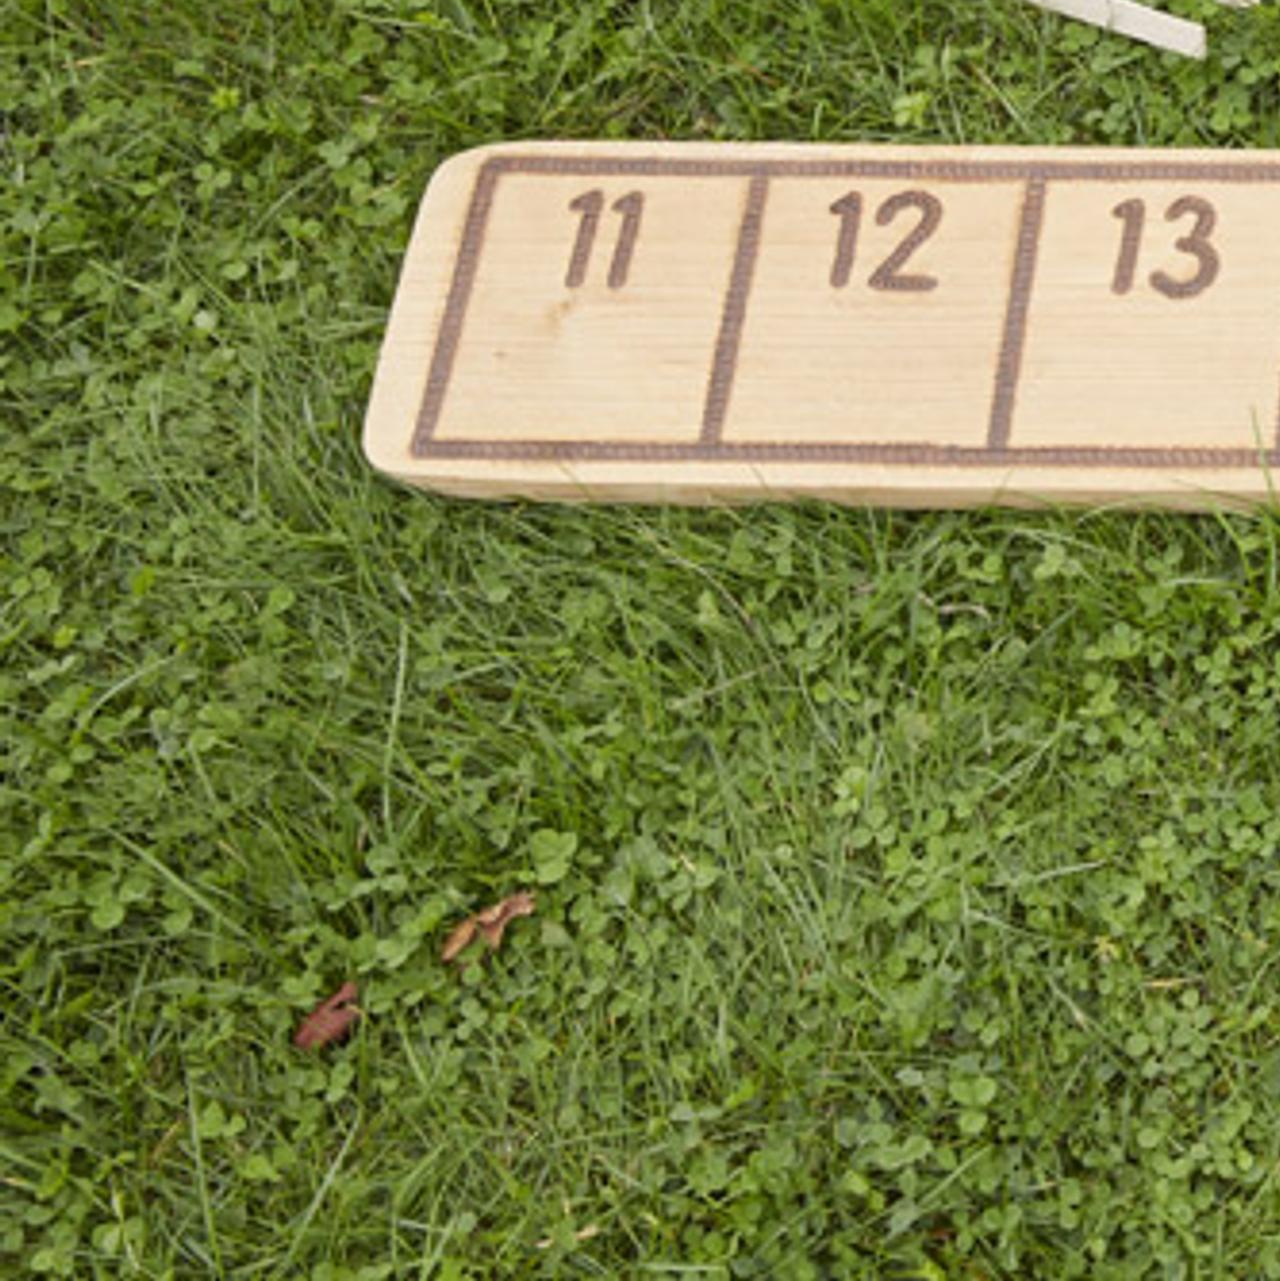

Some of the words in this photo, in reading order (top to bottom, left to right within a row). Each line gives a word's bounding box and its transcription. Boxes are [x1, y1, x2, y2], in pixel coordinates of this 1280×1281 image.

[565, 189, 645, 290] 11
[829, 190, 943, 292] 12
[1111, 195, 1220, 300] 13
